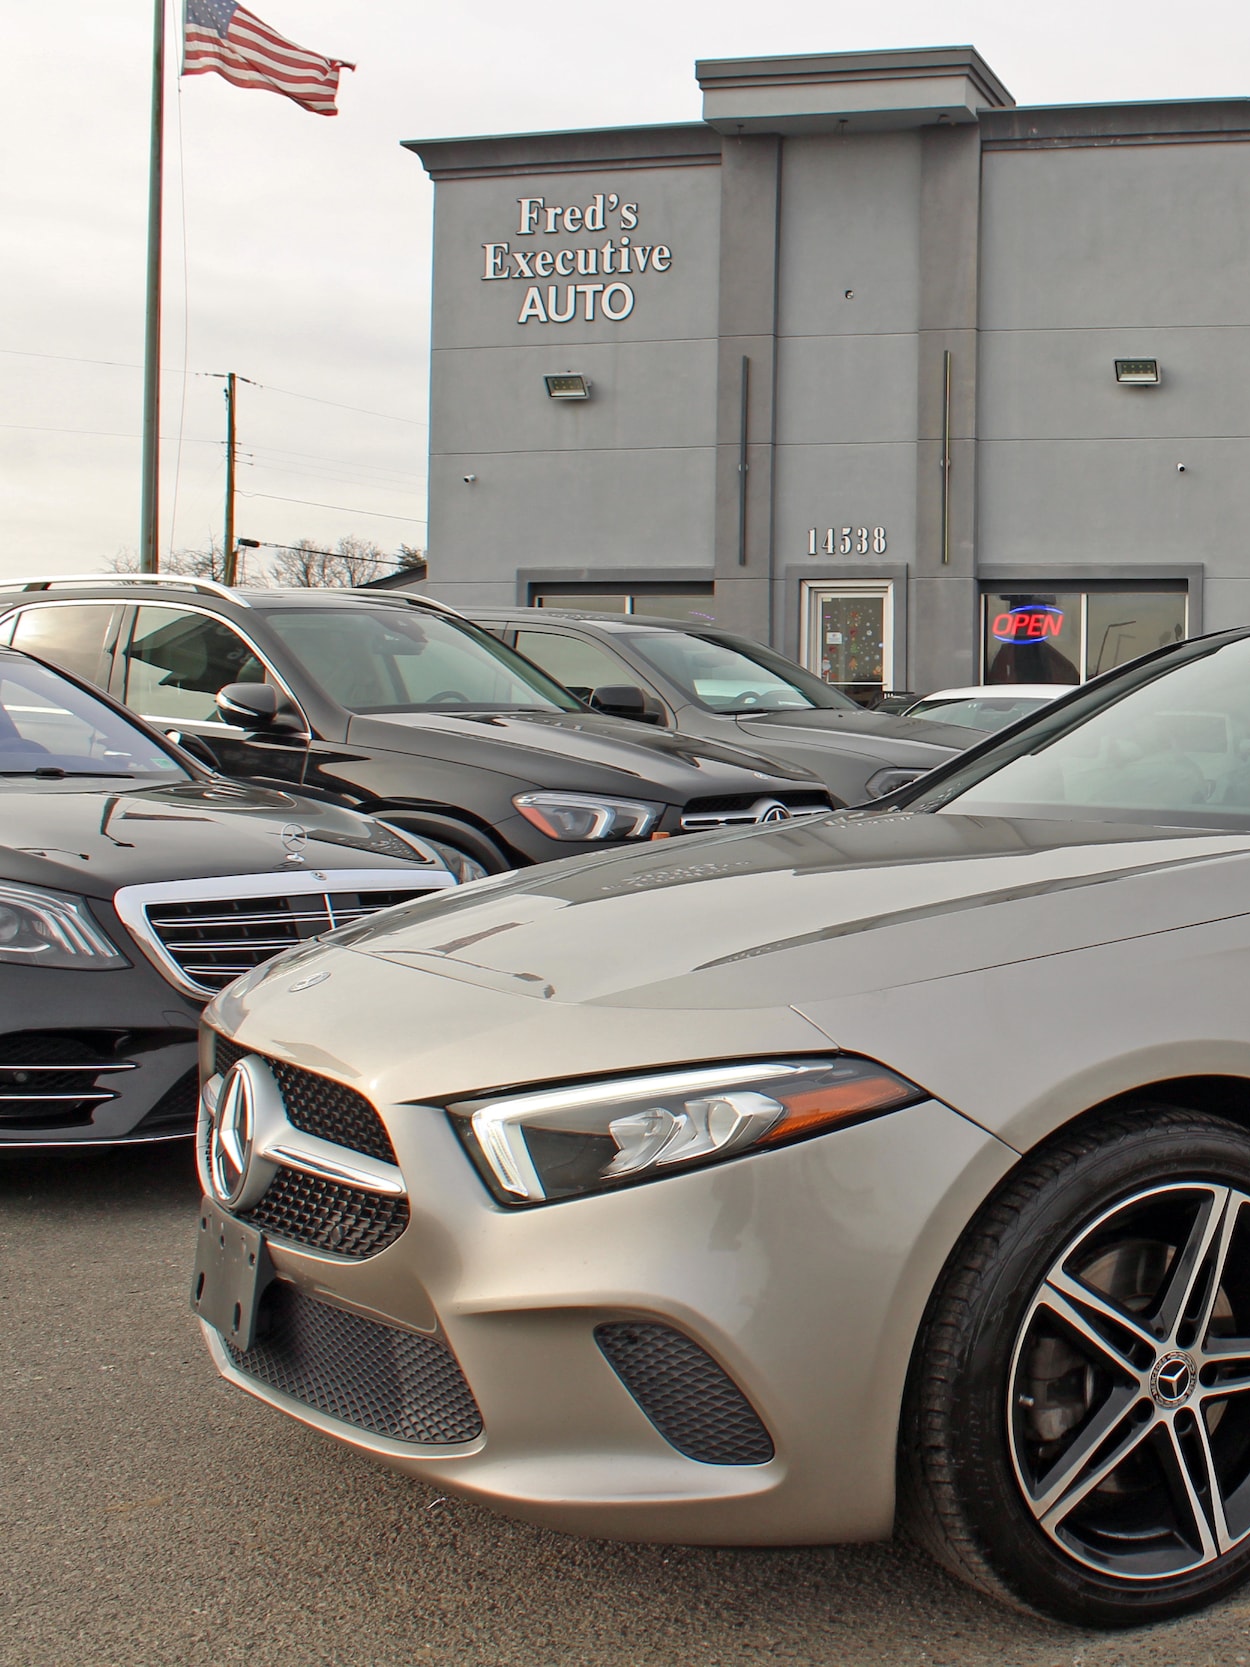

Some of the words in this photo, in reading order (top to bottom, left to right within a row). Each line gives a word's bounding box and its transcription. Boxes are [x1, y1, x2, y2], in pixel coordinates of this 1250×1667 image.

[516, 193, 639, 235] Fred's
[481, 236, 672, 280] Executive
[517, 281, 635, 324] AUTO
[808, 526, 887, 555] 14538
[992, 613, 1064, 637] OPEN
